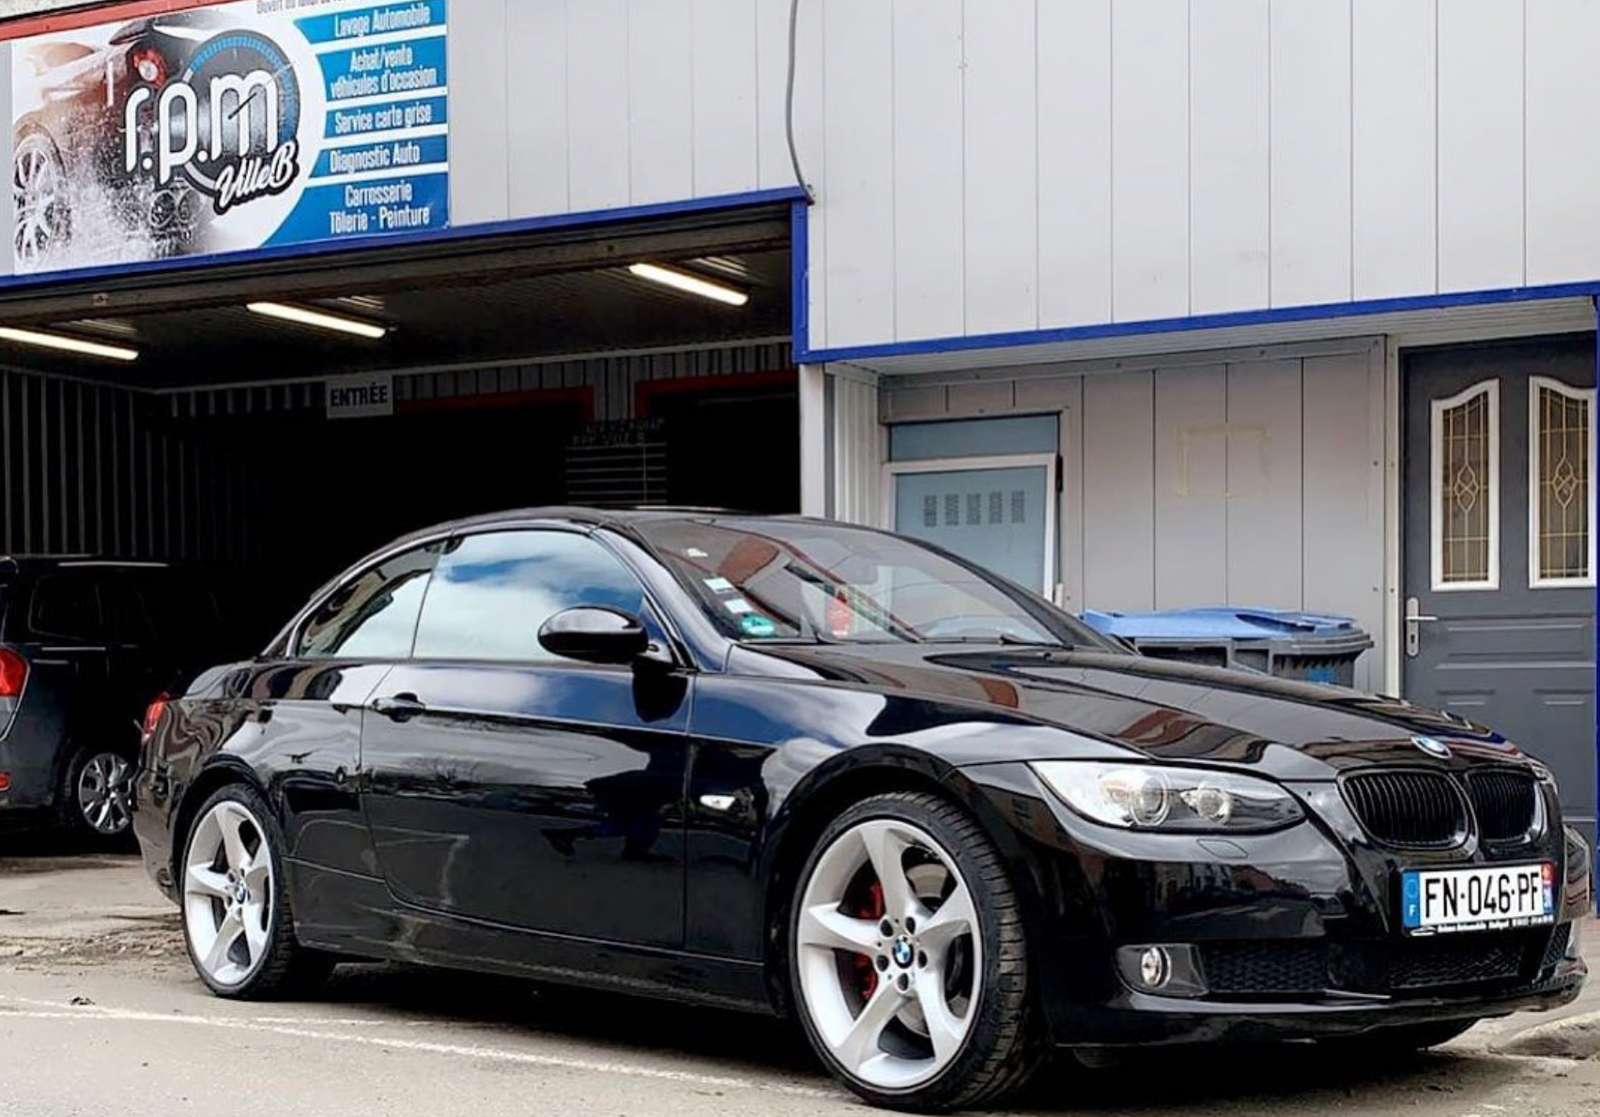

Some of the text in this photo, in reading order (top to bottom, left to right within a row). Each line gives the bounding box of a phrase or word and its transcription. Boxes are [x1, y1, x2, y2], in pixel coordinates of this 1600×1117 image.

[335, 3, 430, 38] Lavage Automobile
[350, 44, 413, 72] Achat/vente
[330, 65, 437, 98] véhicules d'occasion
[335, 101, 432, 134] Service carte grise
[330, 141, 420, 174] Diagnostic Auto
[345, 179, 413, 208] Carrosserie
[329, 209, 369, 234] Tôlerie
[379, 204, 430, 229] Peinture
[331, 381, 388, 407] ENTRÉE
